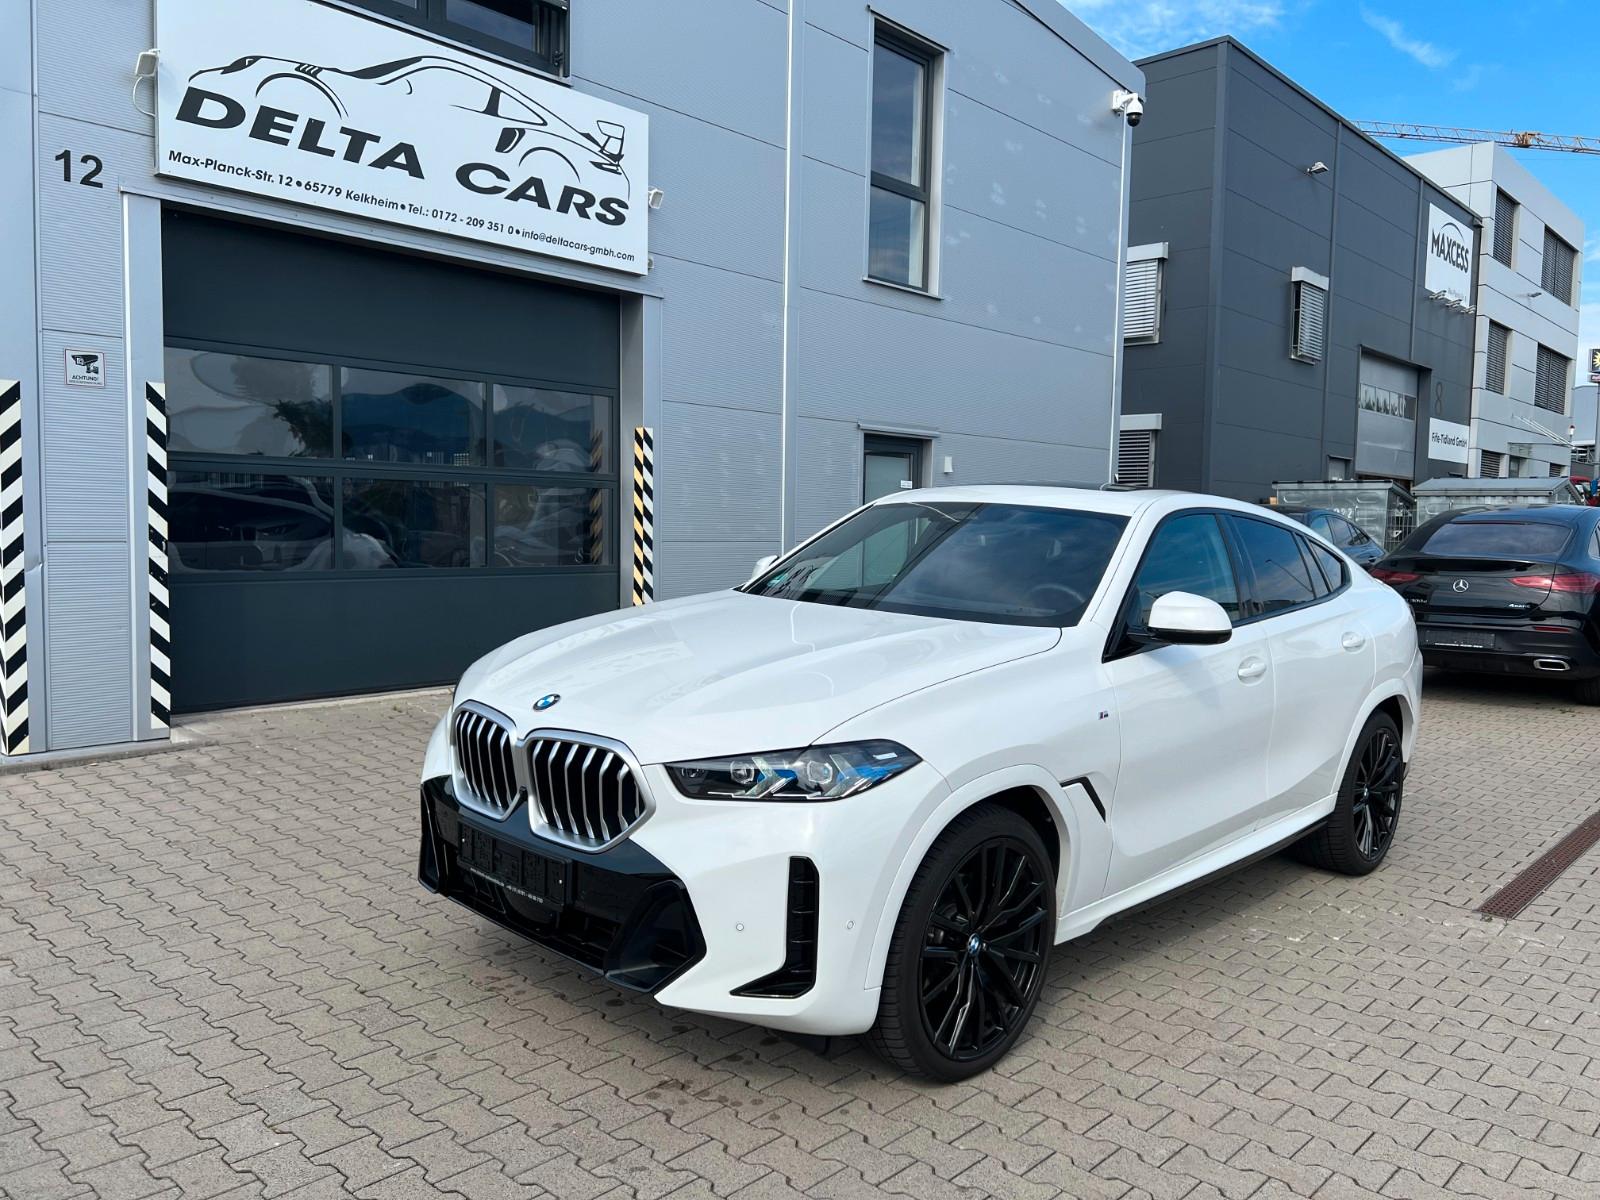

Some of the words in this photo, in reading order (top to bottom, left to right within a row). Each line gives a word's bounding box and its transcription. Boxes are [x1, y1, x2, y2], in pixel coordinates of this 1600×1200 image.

[55, 149, 103, 188] 12
[175, 86, 425, 180] DELTA
[455, 162, 630, 226] CARS
[168, 150, 275, 183] Max-Planck-Str.
[278, 174, 293, 187] 12
[304, 180, 342, 197] 65779
[345, 189, 399, 210] Kelkheim
[408, 203, 429, 217] Tel.:
[431, 209, 458, 223] 0172
[466, 216, 485, 229] 209
[487, 221, 504, 232] 351
[507, 225, 514, 235] 0
[521, 228, 635, 261] info@deltacars-gmbh.com
[1431, 228, 1470, 273] MAXCESS
[1434, 381, 1443, 417] 8
